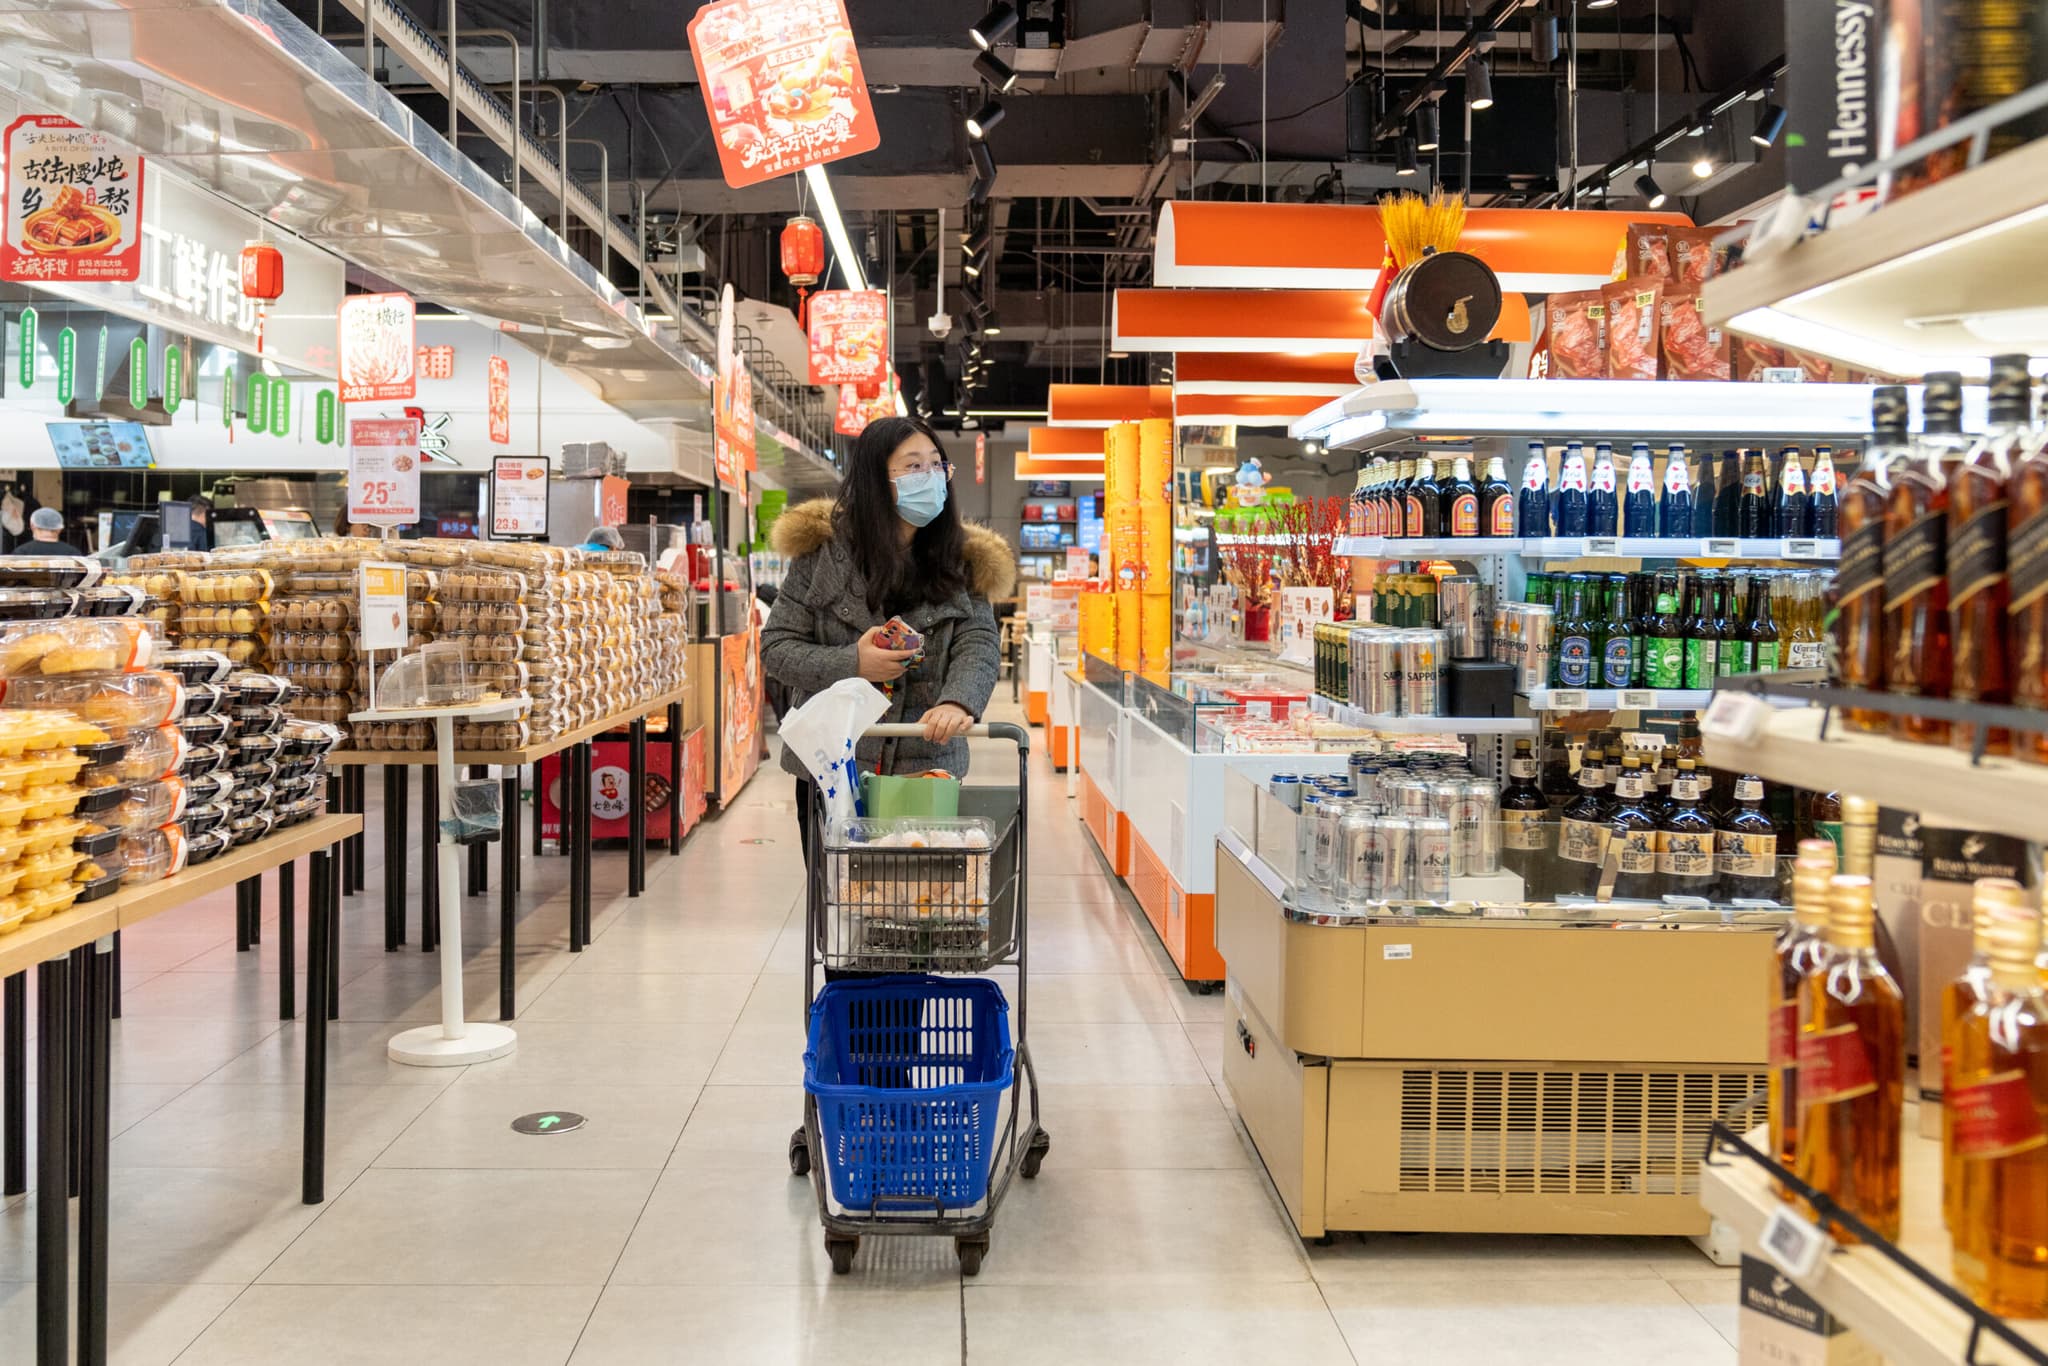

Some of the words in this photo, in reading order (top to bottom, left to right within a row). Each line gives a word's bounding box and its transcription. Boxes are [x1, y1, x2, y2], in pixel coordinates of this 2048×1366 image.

[1828, 0, 1873, 158] Hennessy
[496, 517, 519, 530] 23.9
[1647, 650, 1657, 672] IPA
[1357, 852, 1384, 865] Asahi
